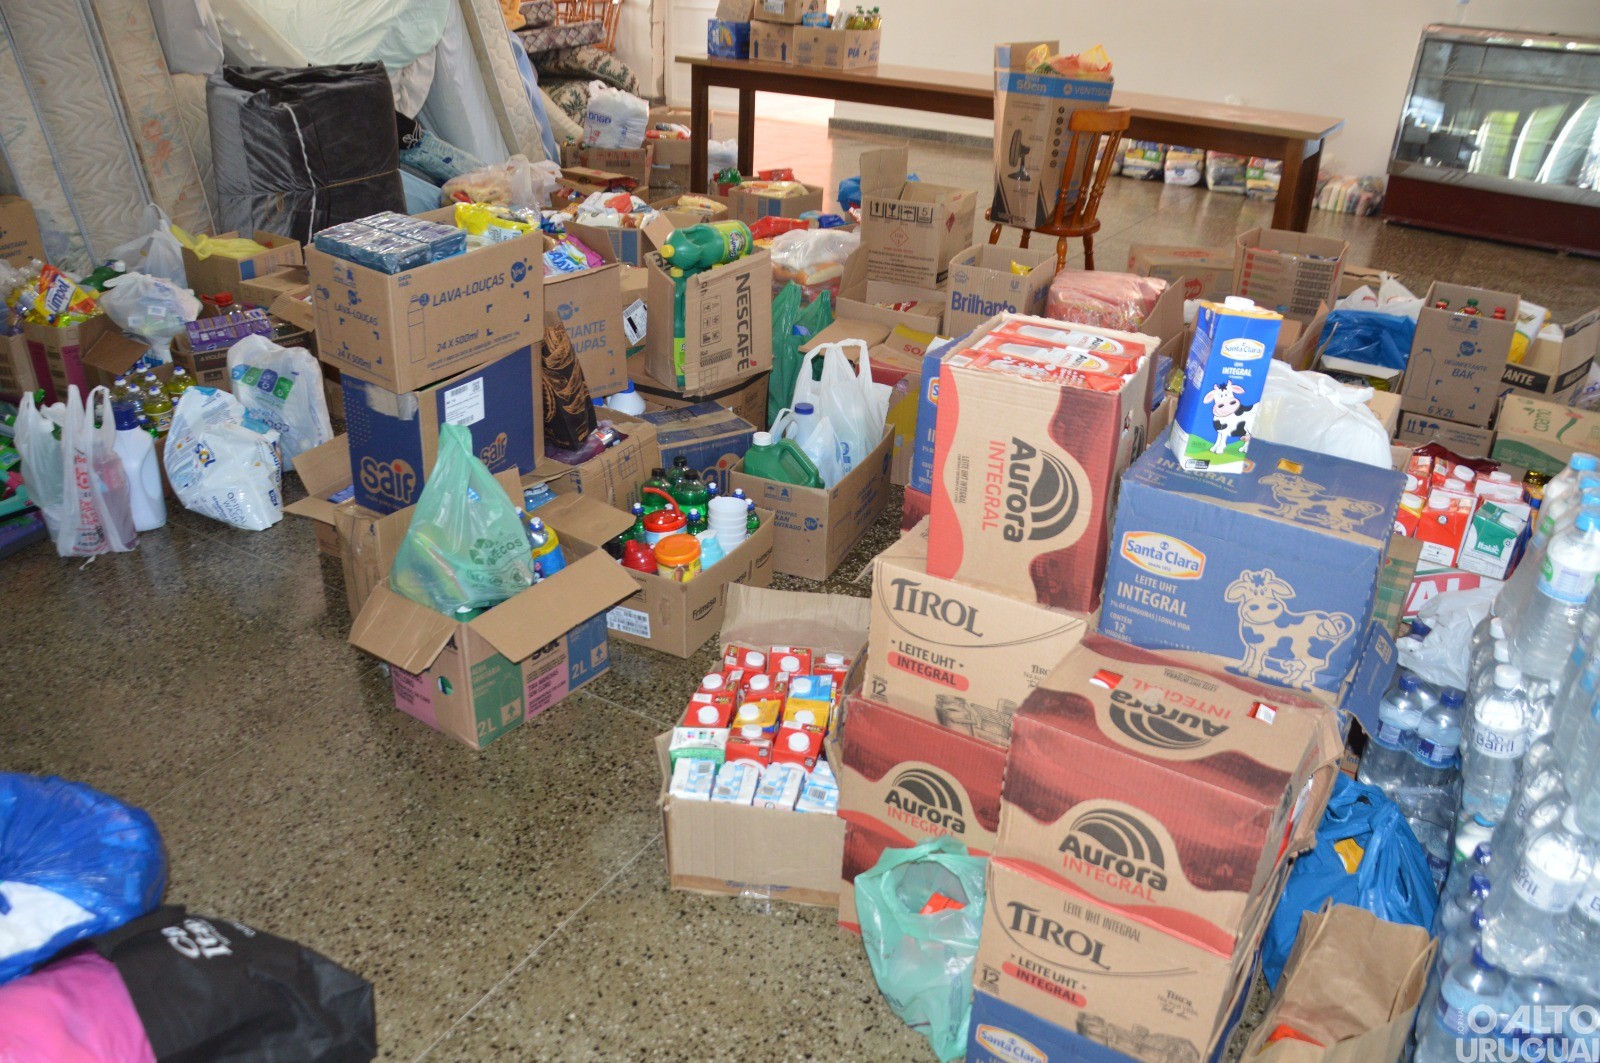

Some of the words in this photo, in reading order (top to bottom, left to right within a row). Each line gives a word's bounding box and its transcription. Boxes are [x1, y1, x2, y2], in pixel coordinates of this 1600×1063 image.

[1016, 79, 1047, 93] 50cm
[47, 279, 71, 313] Limpol
[432, 273, 505, 307] LAVA-LOUÇAS
[334, 303, 379, 326] LAVA-LOUÇAS
[437, 341, 447, 352] 24
[456, 329, 479, 346] 500ml
[1224, 344, 1243, 353] Santa
[1244, 346, 1261, 354] Clara
[1222, 367, 1252, 376] INTEGRAL
[1452, 368, 1475, 380] BAK
[1503, 367, 1536, 386] ANTE
[1427, 405, 1433, 414] 6
[1436, 406, 1443, 415] X
[481, 438, 508, 466] saif
[363, 457, 414, 503] saif
[982, 440, 1006, 531] INTEGRAL
[1003, 436, 1037, 543] Aurora
[1126, 539, 1162, 561] Santa
[1164, 550, 1200, 572] Clara
[1134, 573, 1157, 587] LEITE
[1159, 580, 1178, 594] UHT
[692, 597, 717, 619] Frimesa
[891, 578, 984, 638] TIROL
[1117, 581, 1188, 618] INTEGRAL
[1114, 621, 1126, 633] 12
[1126, 605, 1155, 620] GORDURAS
[1159, 616, 1176, 627] LONGA
[1178, 621, 1190, 631] VIDA
[898, 641, 929, 661] LEITE
[931, 651, 956, 669] UHT
[571, 660, 588, 680] 2L
[897, 655, 956, 686] INTEGRAL
[872, 680, 886, 697] 12
[478, 718, 498, 737] 2L
[884, 789, 966, 834] Aurora
[1058, 834, 1168, 892] Aurora
[1062, 854, 1157, 903] INTEGRAL
[1007, 900, 1111, 970] TIROL
[1063, 900, 1083, 919] LEITE
[1085, 907, 1101, 926] UHT
[1102, 915, 1142, 943] INTEGRAL
[981, 968, 999, 985] 12
[1016, 969, 1079, 1004] INTEGRAL
[1018, 956, 1050, 977] LEITE
[1052, 969, 1079, 990] UHT
[981, 1030, 1011, 1052] Santa
